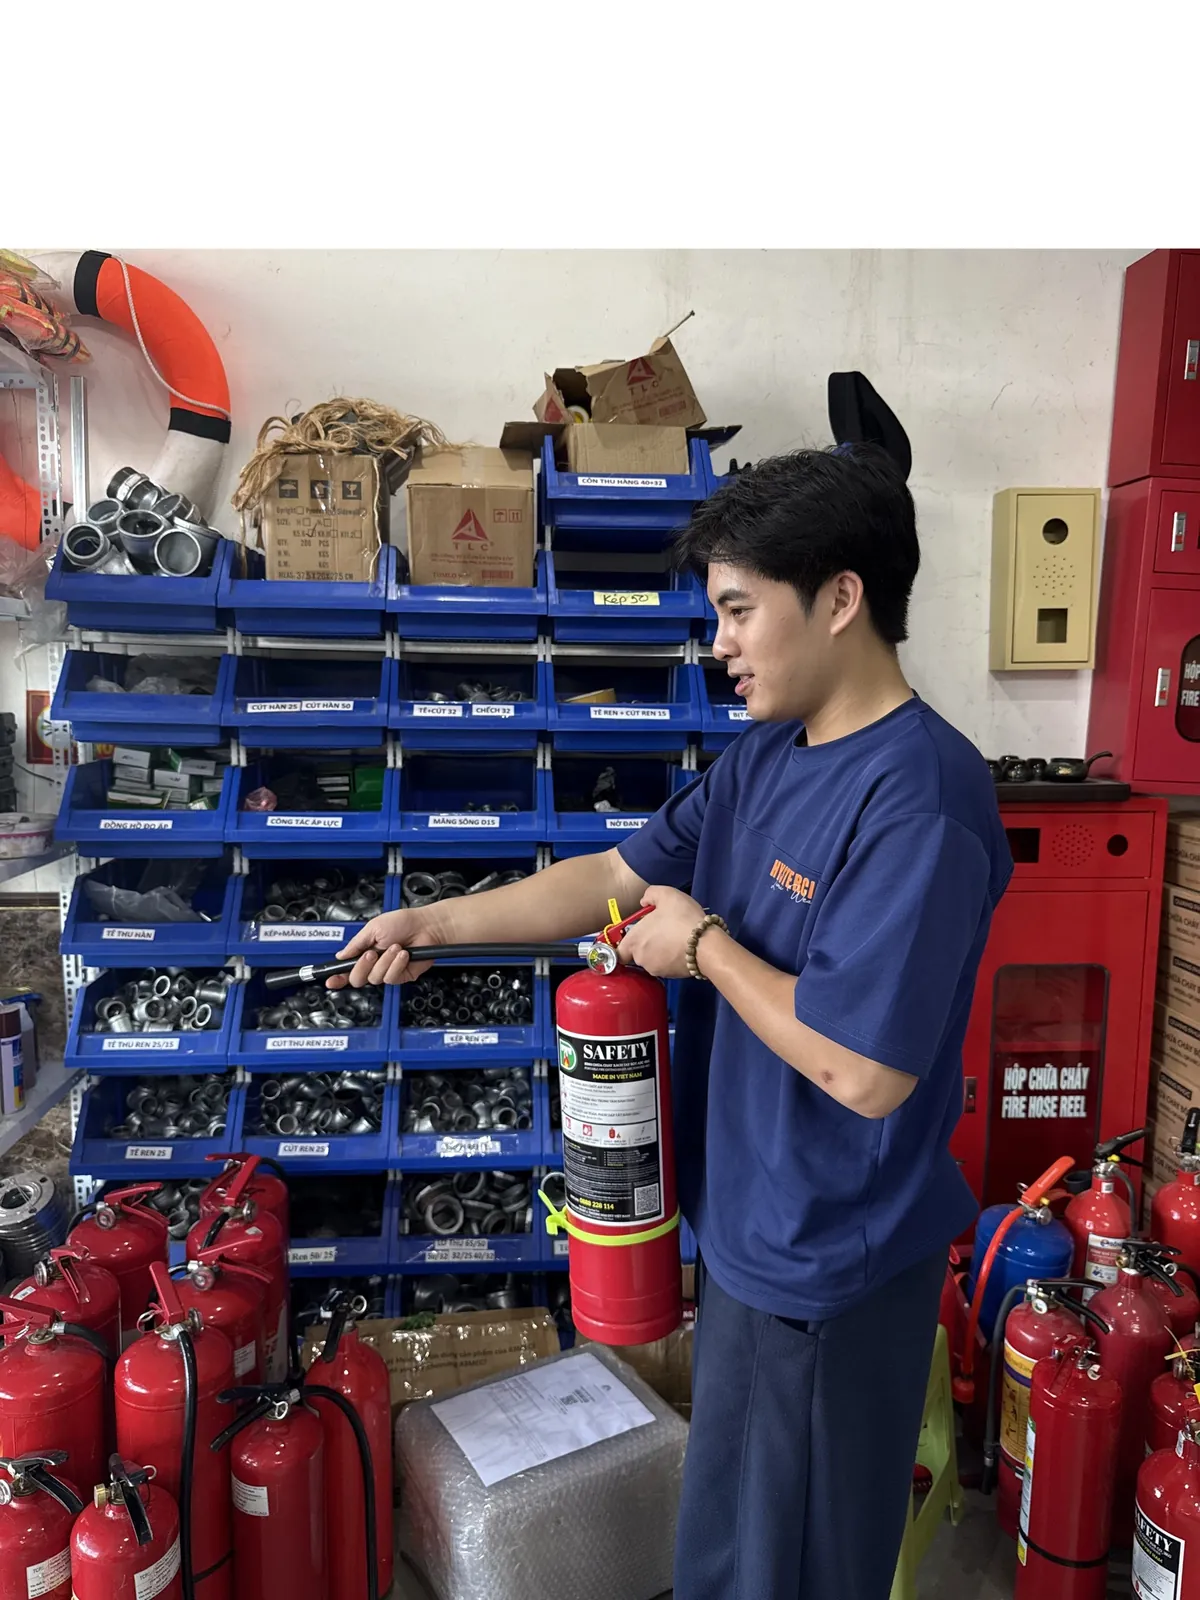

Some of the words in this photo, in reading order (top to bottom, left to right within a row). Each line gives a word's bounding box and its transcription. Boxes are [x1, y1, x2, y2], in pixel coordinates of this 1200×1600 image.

[453, 542, 489, 551] TLC
[630, 594, 649, 604] 50
[1181, 690, 1200, 707] FIRE
[251, 703, 267, 711] CÚT
[305, 701, 321, 709] CÚT
[270, 817, 294, 825] CÔNG
[117, 930, 134, 938] THU
[308, 929, 330, 937] SÔNG
[583, 1041, 650, 1060] SAFETY
[1003, 1062, 1027, 1095] HỘP
[1028, 1062, 1058, 1091] CHỮA
[1060, 1062, 1090, 1090] CHÁY
[1001, 1095, 1027, 1118] FIRE
[1028, 1095, 1058, 1118] HOSE
[1059, 1095, 1087, 1118] REEL
[140, 1149, 157, 1157] REN
[157, 1149, 166, 1157] 25
